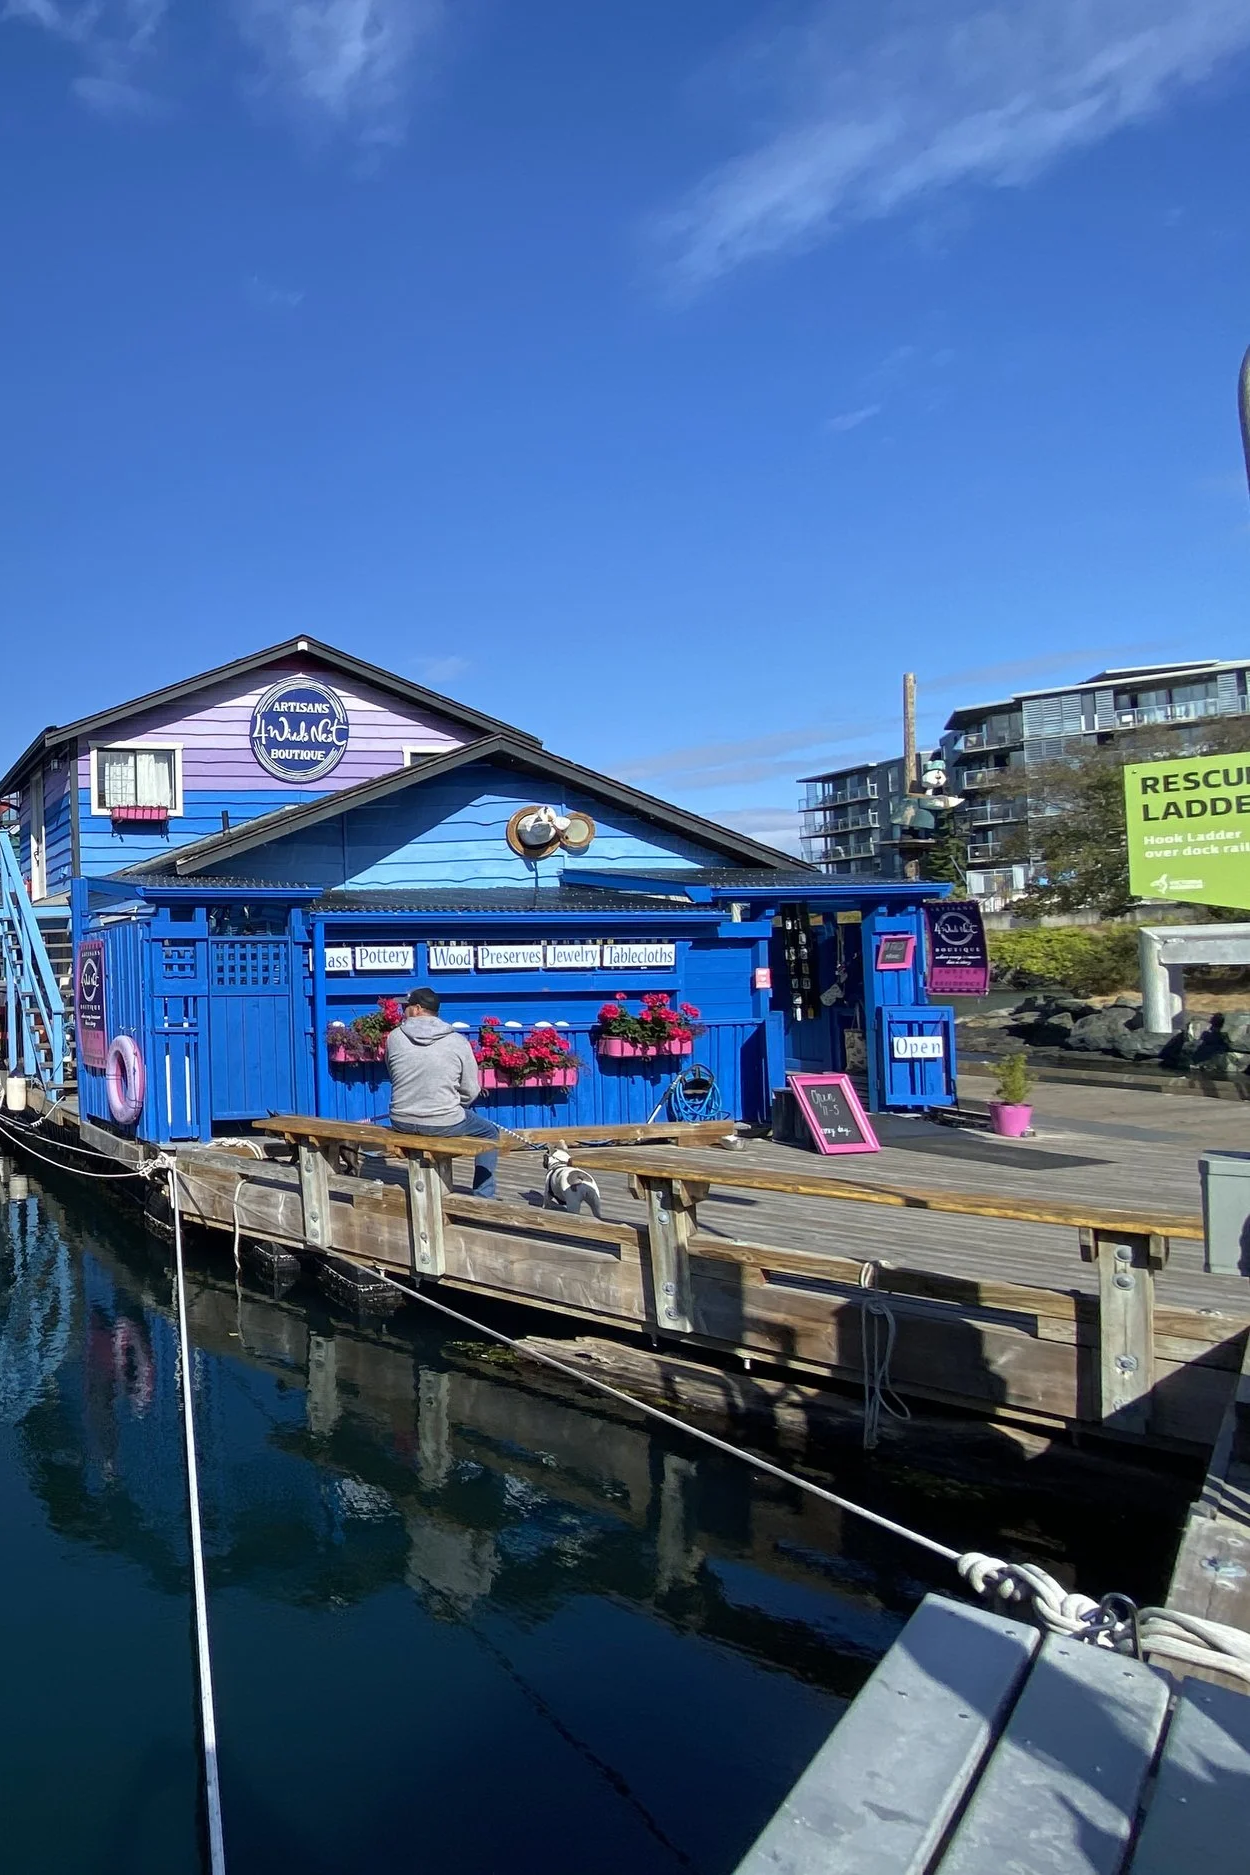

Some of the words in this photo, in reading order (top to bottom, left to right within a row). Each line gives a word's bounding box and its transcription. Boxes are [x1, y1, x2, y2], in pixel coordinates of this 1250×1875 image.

[273, 701, 330, 714] ARTISANS
[252, 713, 268, 745] 4
[310, 717, 349, 747] Nest
[270, 748, 326, 761] BOUTIQUE
[1142, 795, 1250, 822] LADDE
[1143, 833, 1183, 845] Hook
[1187, 829, 1243, 843] Ladder
[1144, 847, 1180, 859] over
[1182, 844, 1219, 856] dock
[359, 947, 410, 968] Pottery
[434, 946, 472, 967] Wood
[480, 947, 542, 967] Preserves
[549, 945, 598, 966] Jewelry
[605, 945, 673, 965] Tablecloths
[895, 1037, 941, 1057] Open
[811, 1089, 836, 1108] Open
